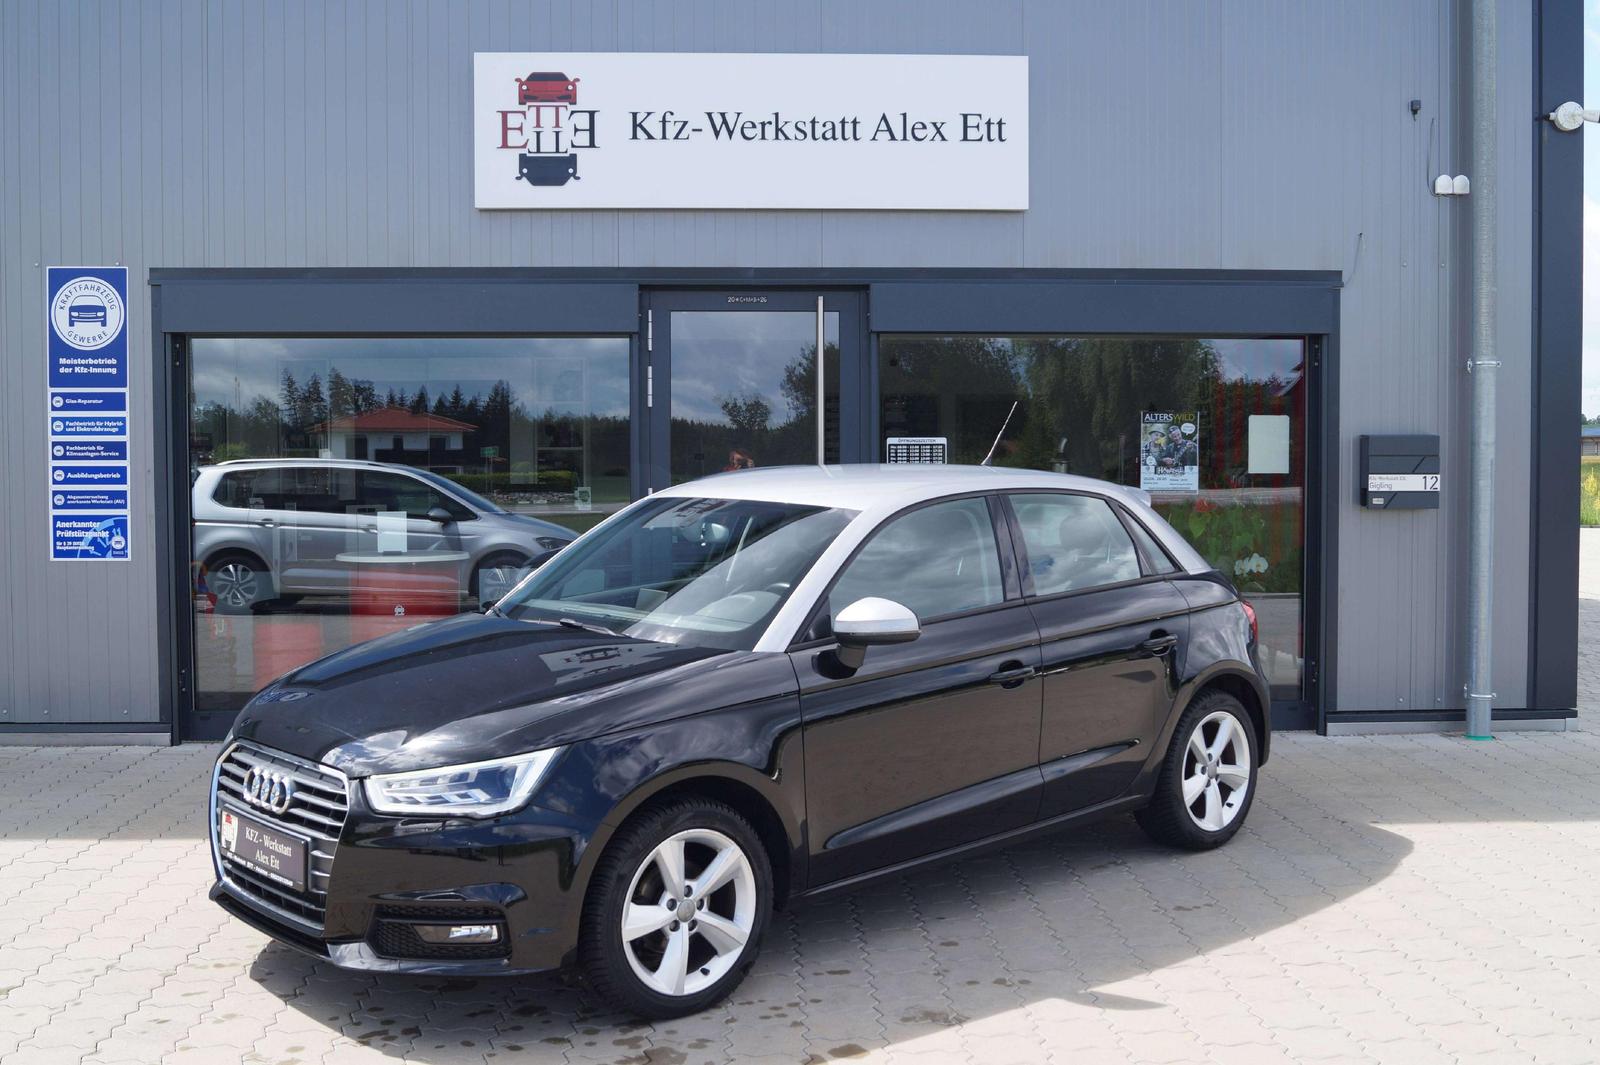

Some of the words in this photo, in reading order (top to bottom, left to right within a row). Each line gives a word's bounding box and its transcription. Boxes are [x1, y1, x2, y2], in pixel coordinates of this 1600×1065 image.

[628, 110, 861, 142] Kfz-Werkstatt
[870, 112, 949, 142] Alex
[959, 113, 1007, 142] Ett
[59, 284, 117, 310] KRAFTFAHRZEUG
[68, 330, 108, 343] GEWERBE
[59, 357, 117, 365] Meisterbetrieb
[59, 366, 72, 374] der
[74, 366, 117, 375] Kfz-Innung
[1422, 475, 1439, 490] 12
[56, 530, 109, 539] Prüfstützpunkt
[245, 827, 259, 844] KFZ
[263, 834, 292, 857] Werkstatt
[255, 849, 270, 867] Alex
[270, 855, 280, 870] Ett
